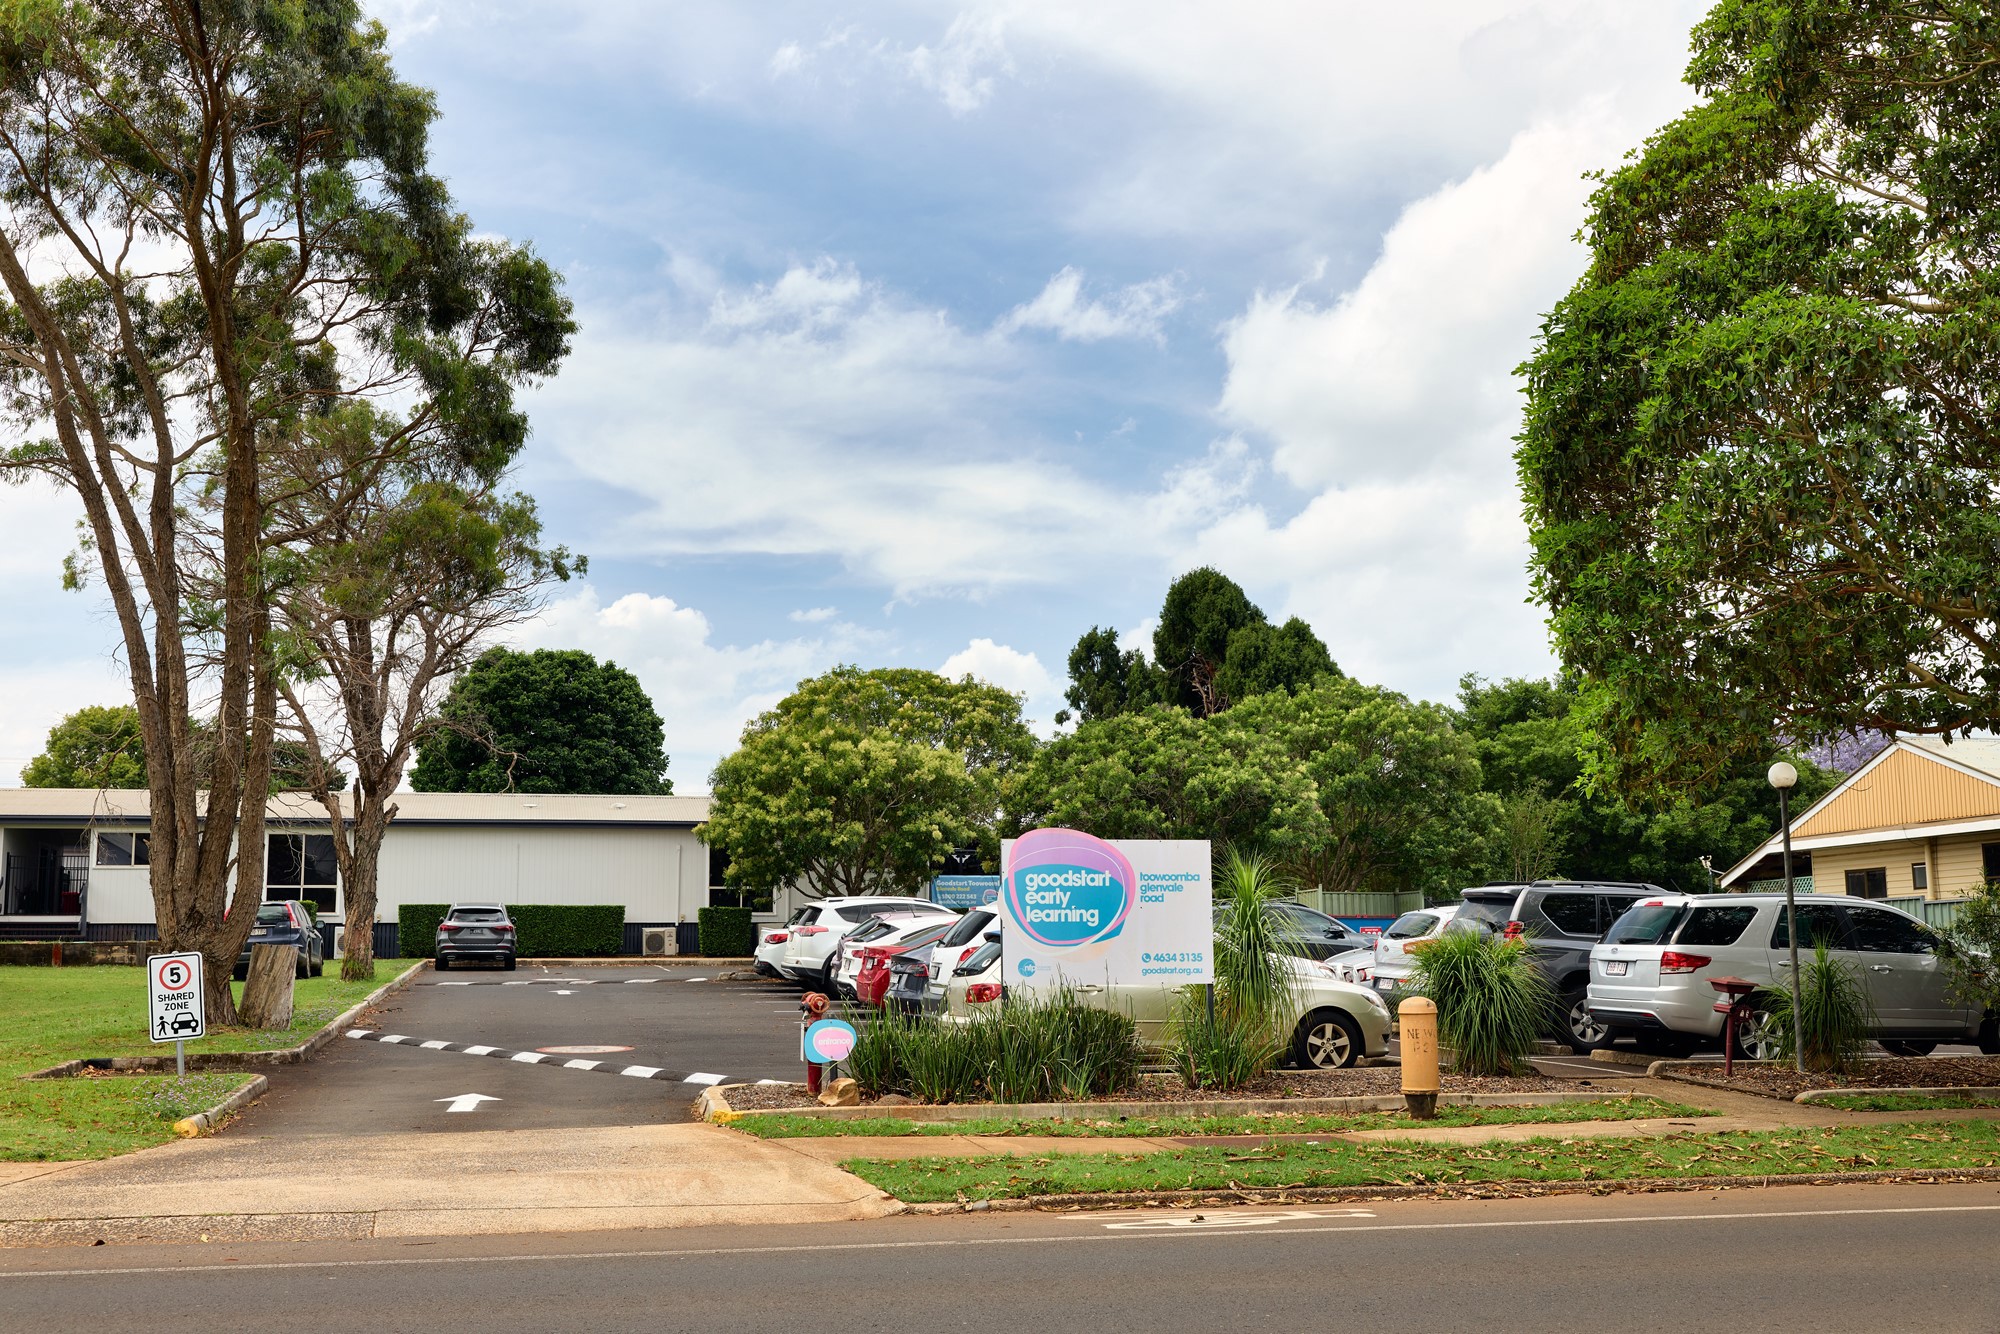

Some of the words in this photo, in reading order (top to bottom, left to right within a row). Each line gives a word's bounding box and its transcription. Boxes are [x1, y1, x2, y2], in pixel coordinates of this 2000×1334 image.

[1025, 870, 1111, 891] goodstart
[1140, 872, 1200, 882] toowoomba
[1140, 882, 1184, 894] glenvale
[1025, 888, 1071, 906] early
[1140, 893, 1164, 903] road
[1026, 905, 1100, 927] learning
[1153, 953, 1177, 963] 4634
[1179, 953, 1203, 963] 3135
[169, 966, 181, 984] 5
[1141, 966, 1203, 976] goodstart.org.au
[157, 991, 195, 1002] SHARED
[164, 1001, 189, 1011] ZONE
